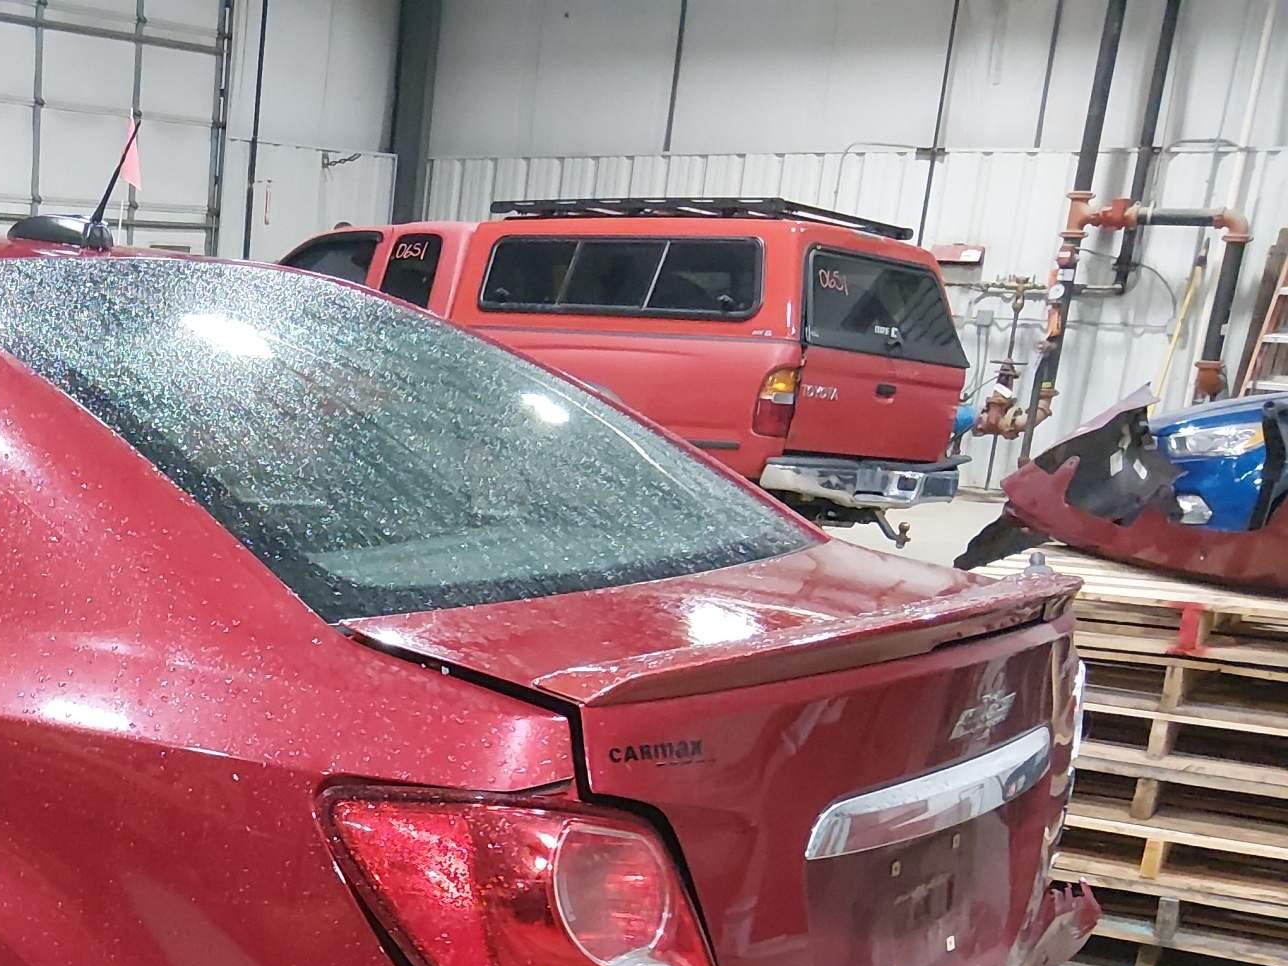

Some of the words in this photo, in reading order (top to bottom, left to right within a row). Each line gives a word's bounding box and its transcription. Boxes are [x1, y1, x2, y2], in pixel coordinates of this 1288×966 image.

[395, 241, 429, 260] 0651
[818, 269, 849, 296] 0651
[801, 384, 839, 401] TOYOTA
